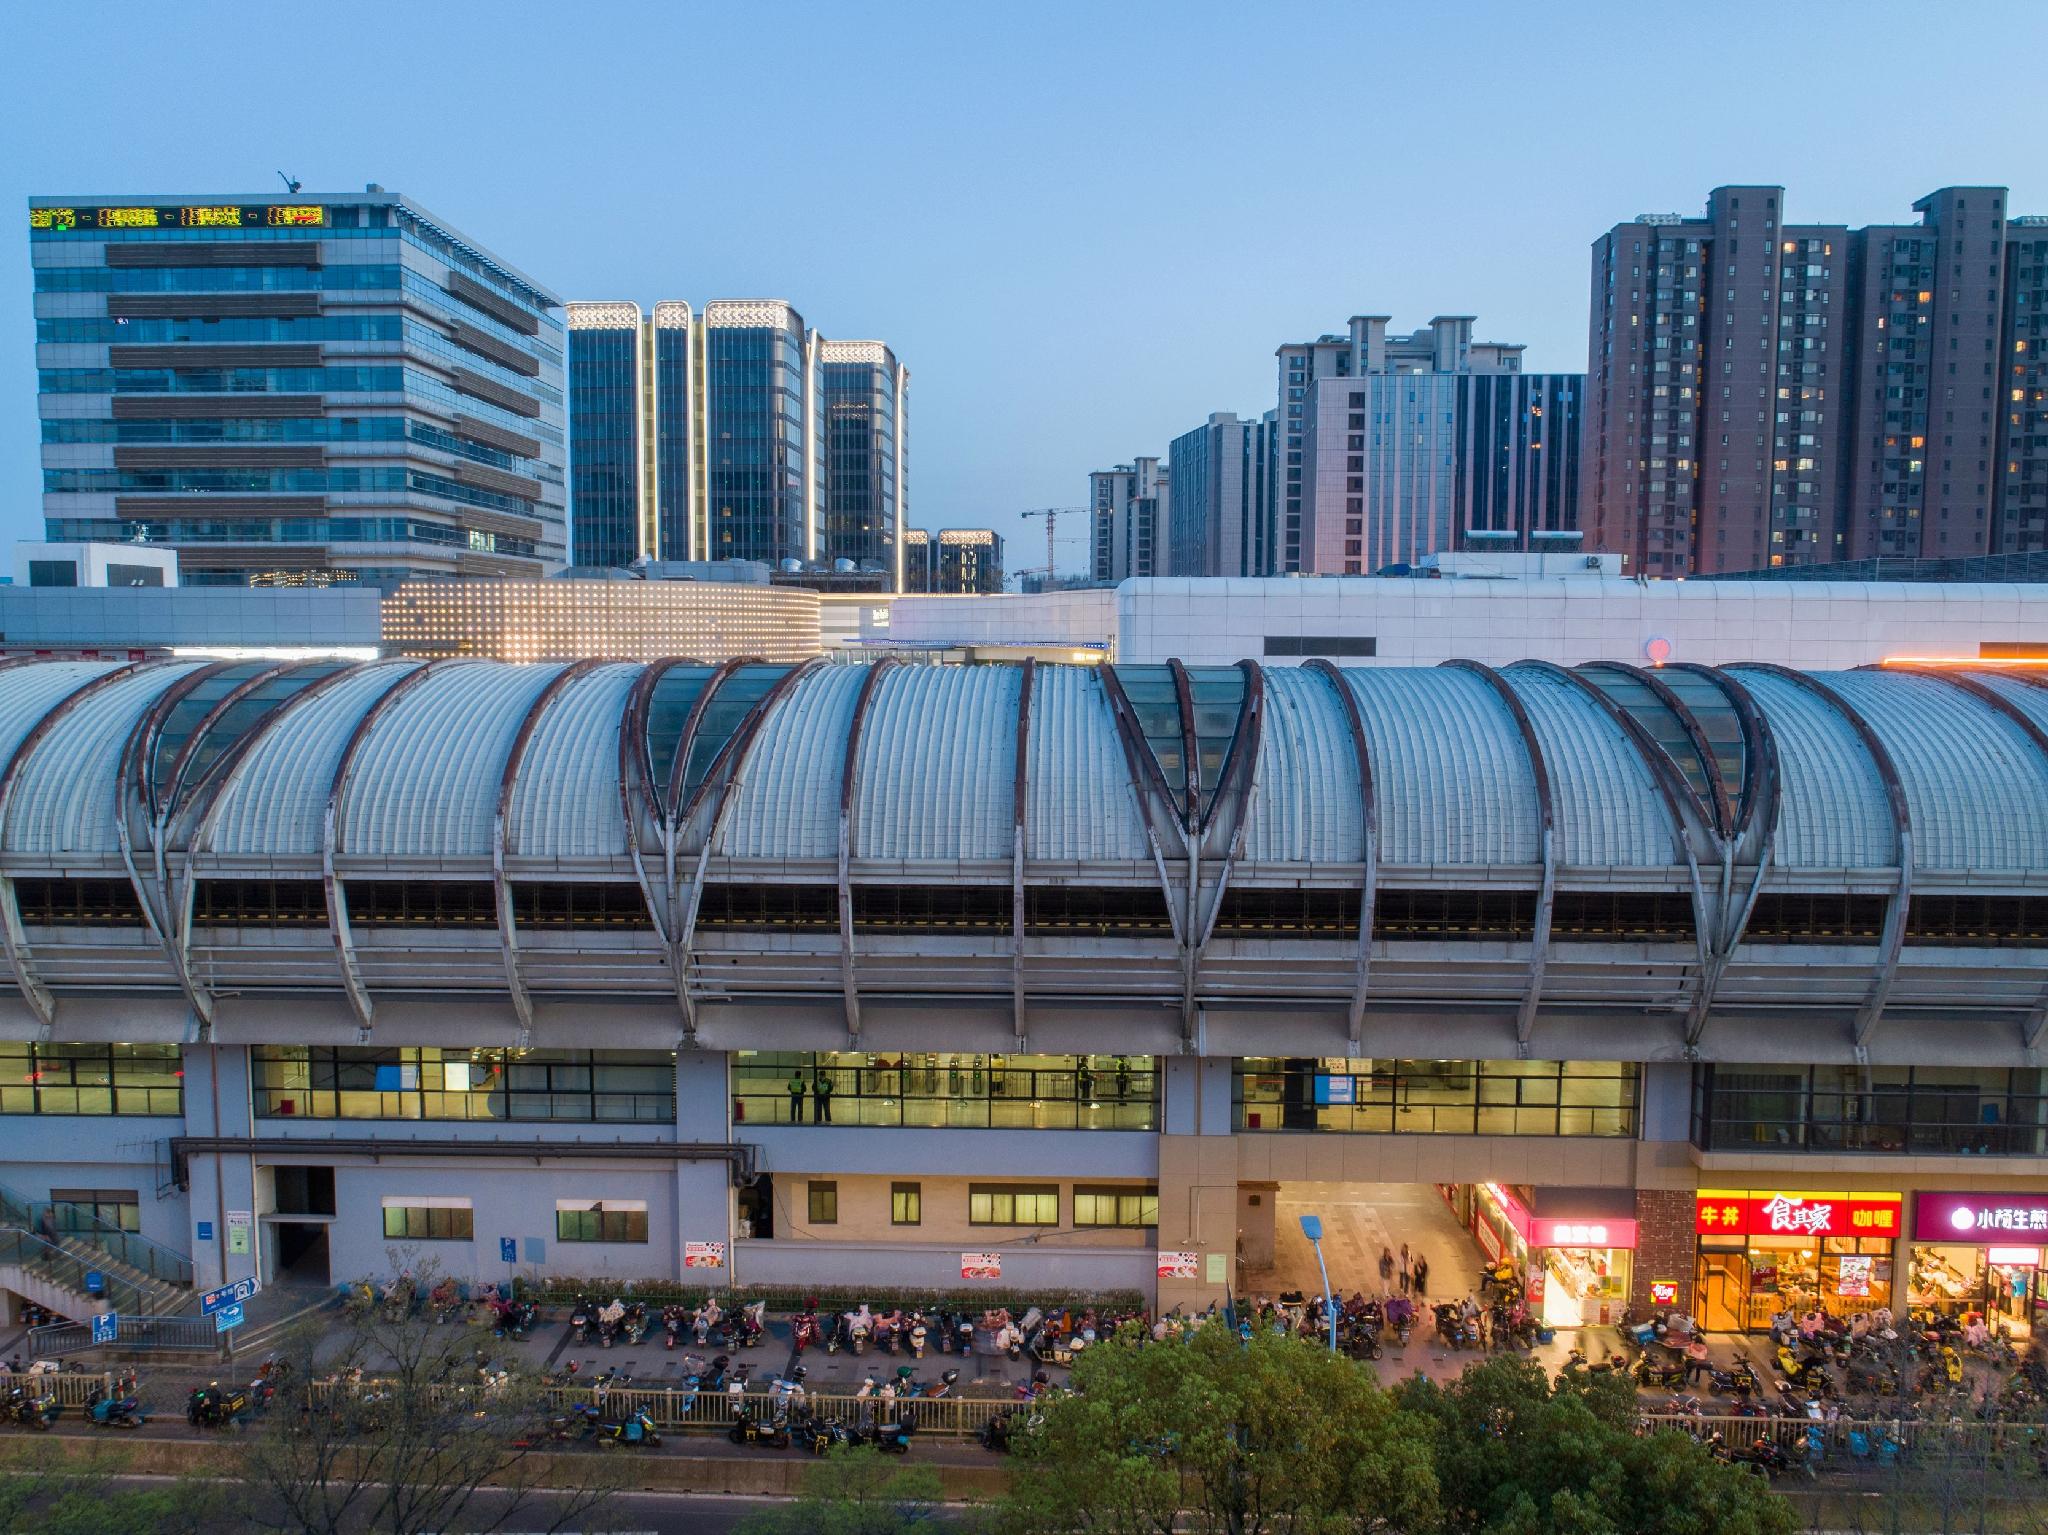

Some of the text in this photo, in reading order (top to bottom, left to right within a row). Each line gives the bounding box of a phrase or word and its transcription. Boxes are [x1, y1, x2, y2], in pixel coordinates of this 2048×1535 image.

[1700, 1194, 1894, 1235] 牛丼 食其家 咖喱
[100, 1315, 110, 1326] P
